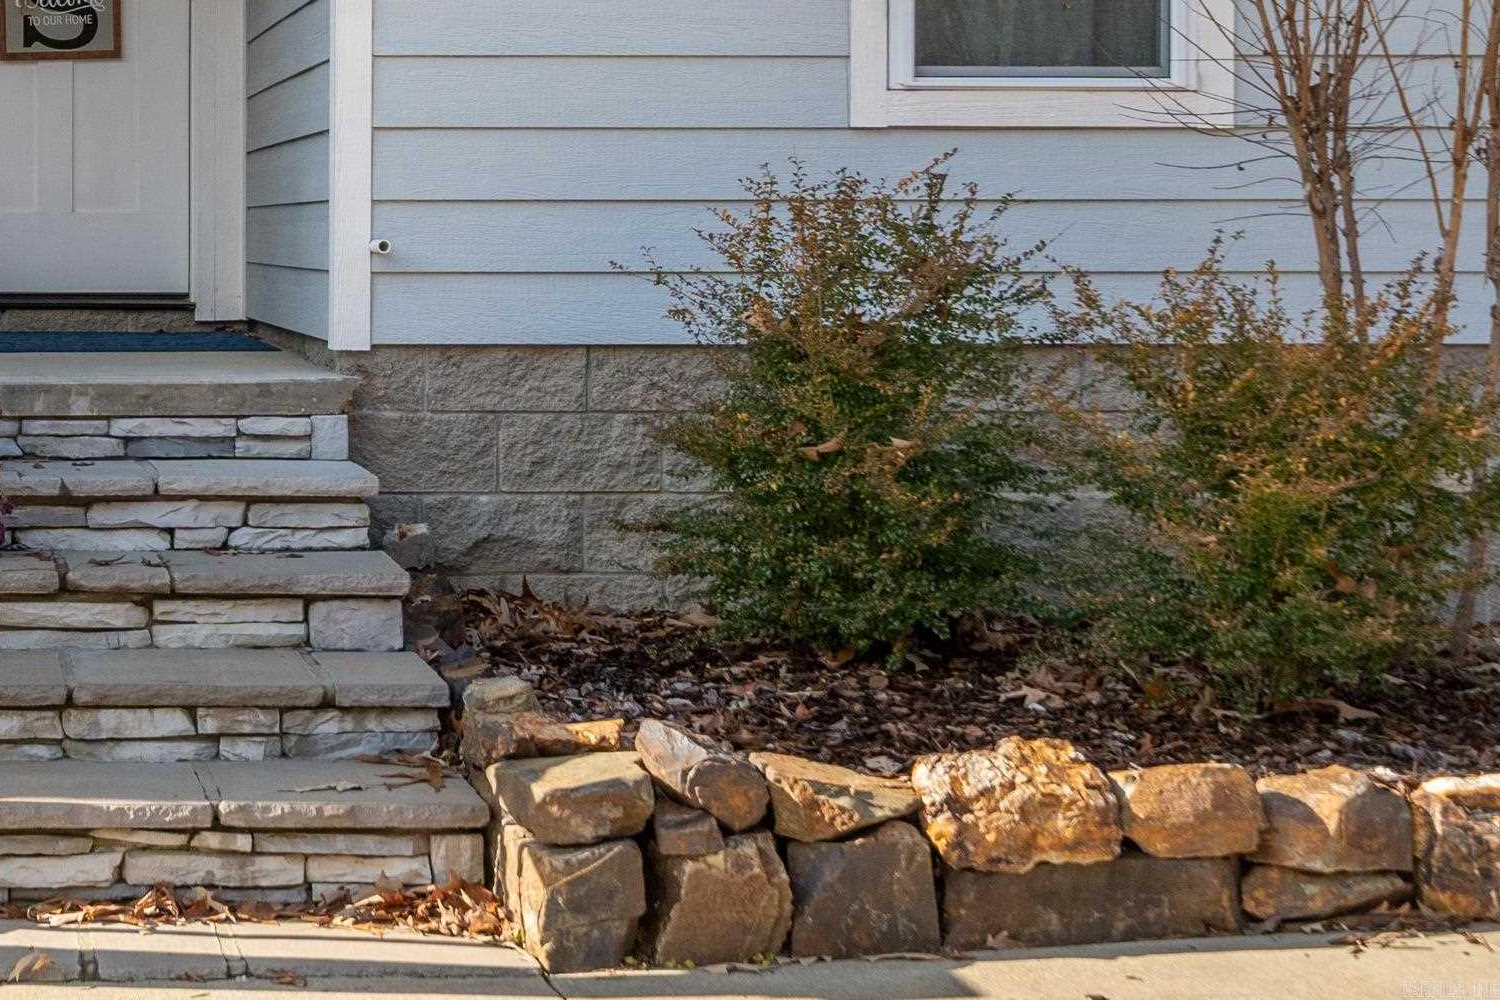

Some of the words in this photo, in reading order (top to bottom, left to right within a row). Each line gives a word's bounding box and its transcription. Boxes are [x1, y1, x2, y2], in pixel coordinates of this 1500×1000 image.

[28, 15, 41, 27] TO
[43, 15, 63, 26] OUR
[65, 14, 93, 25] HOME
